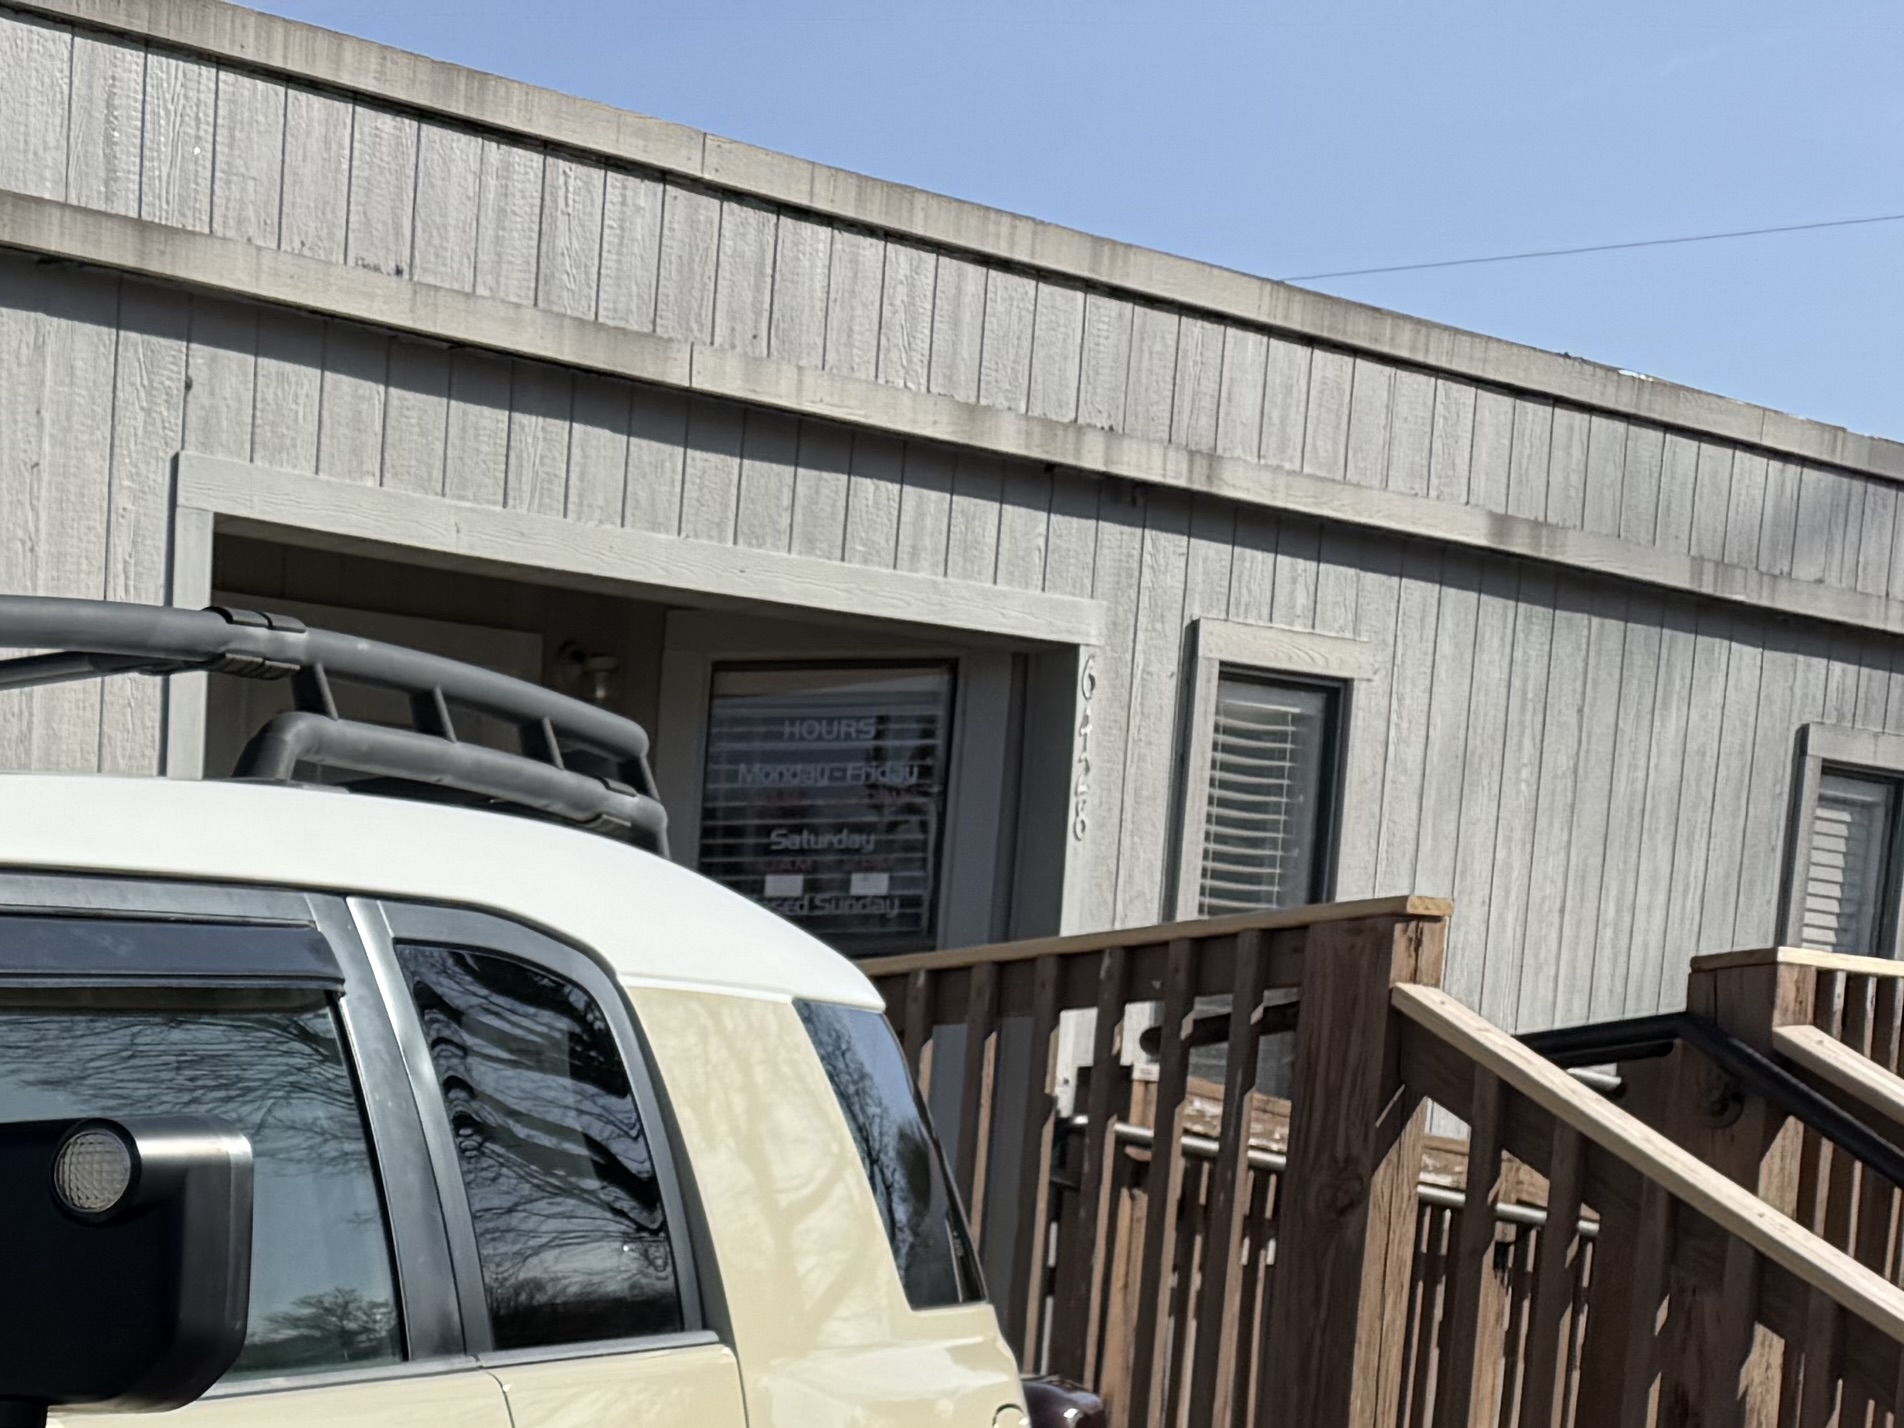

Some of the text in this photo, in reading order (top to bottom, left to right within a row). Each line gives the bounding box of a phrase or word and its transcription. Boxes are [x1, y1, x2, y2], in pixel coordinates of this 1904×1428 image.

[782, 719, 877, 741] HOURS
[769, 829, 876, 853] Saturday
[814, 895, 900, 918] Sunday
